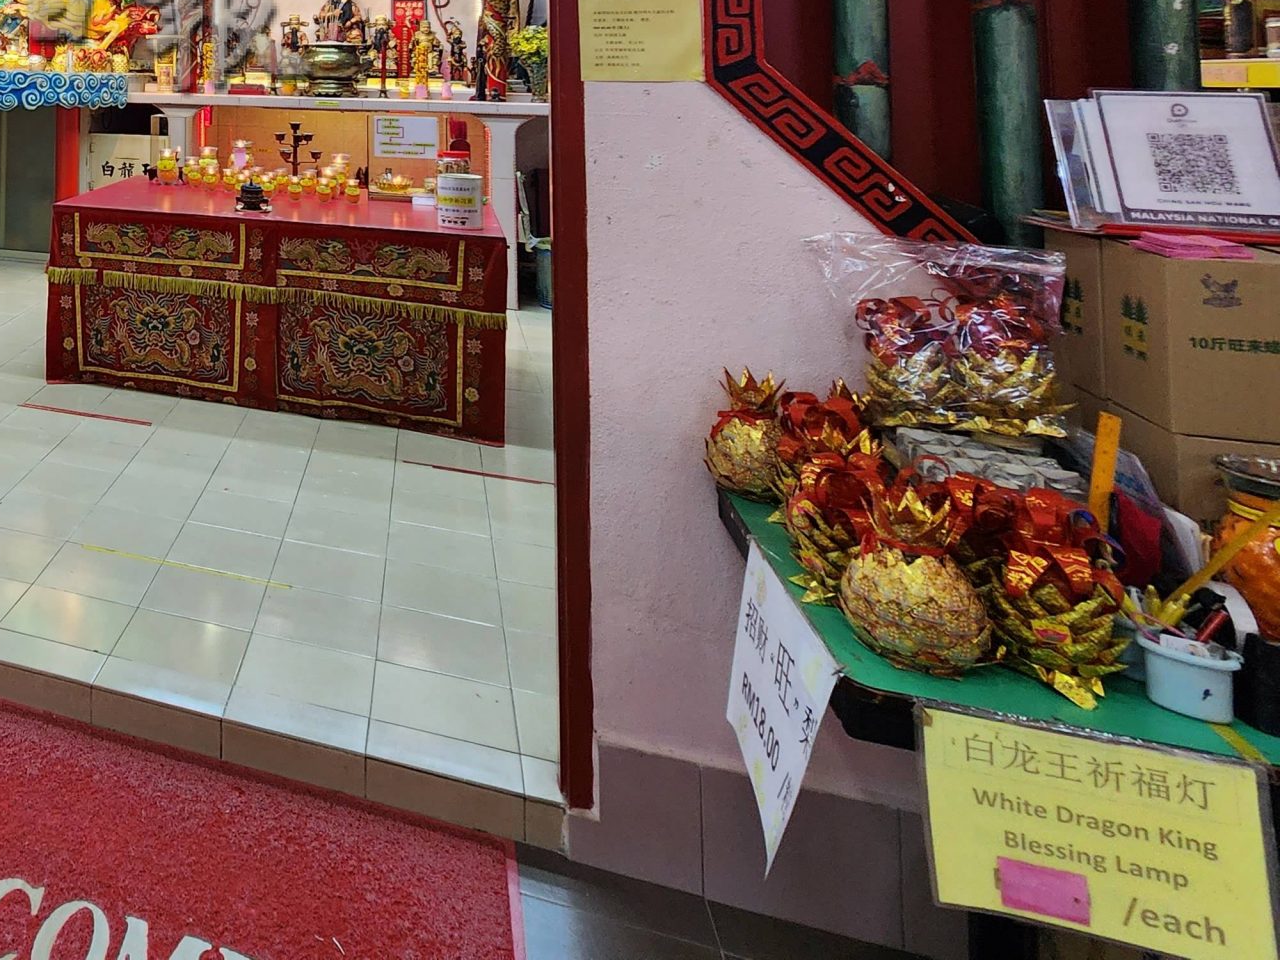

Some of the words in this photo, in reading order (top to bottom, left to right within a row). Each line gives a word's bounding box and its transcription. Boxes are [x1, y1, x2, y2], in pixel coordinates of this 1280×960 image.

[1130, 211, 1195, 223] MALAYSIA
[1198, 213, 1263, 227] NATIONAL
[741, 671, 781, 772] RM18.00
[964, 732, 1217, 811] 白龙王祈福灯
[972, 786, 1048, 821] White
[1056, 804, 1150, 841] Dragon
[1158, 825, 1219, 862] King
[1004, 830, 1108, 874] Blessing
[1116, 853, 1191, 890] Lamp
[1122, 897, 1228, 947] /each
